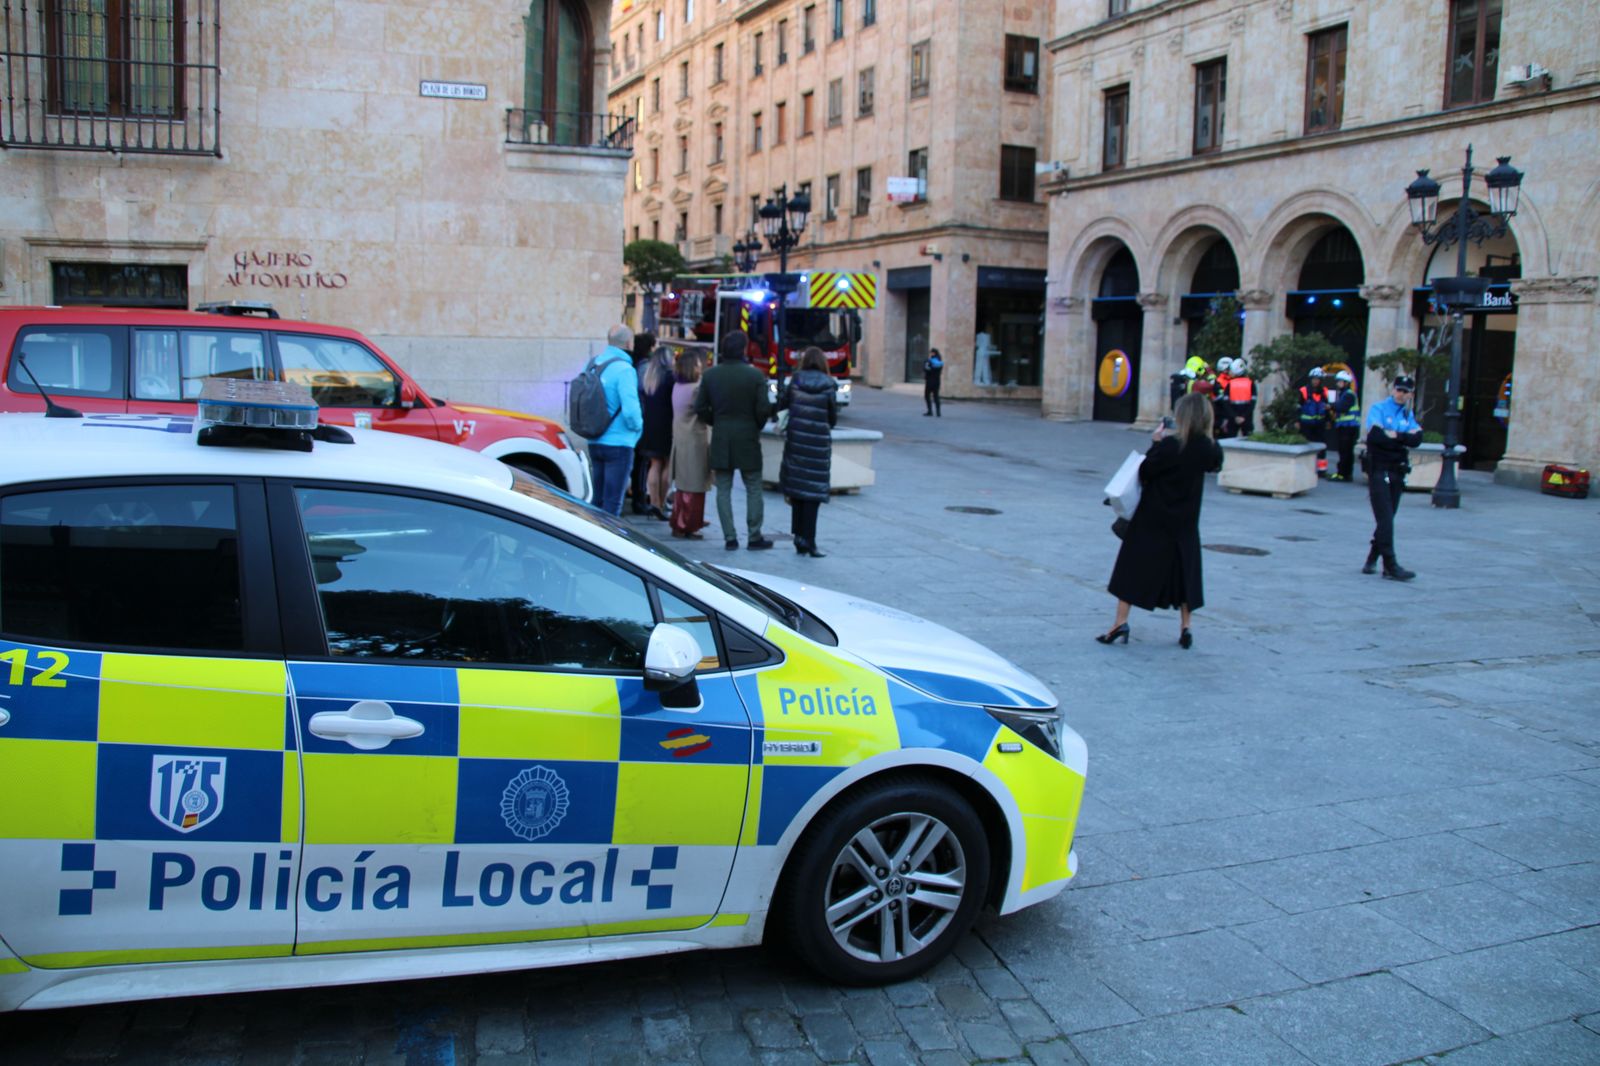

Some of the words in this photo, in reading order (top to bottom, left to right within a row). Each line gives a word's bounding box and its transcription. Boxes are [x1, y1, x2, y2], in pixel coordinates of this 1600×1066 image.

[1483, 292, 1513, 307] Bank
[778, 687, 877, 716] Policía
[763, 743, 810, 753] HYBRID
[149, 850, 411, 912] Policía
[442, 848, 619, 908] Local
